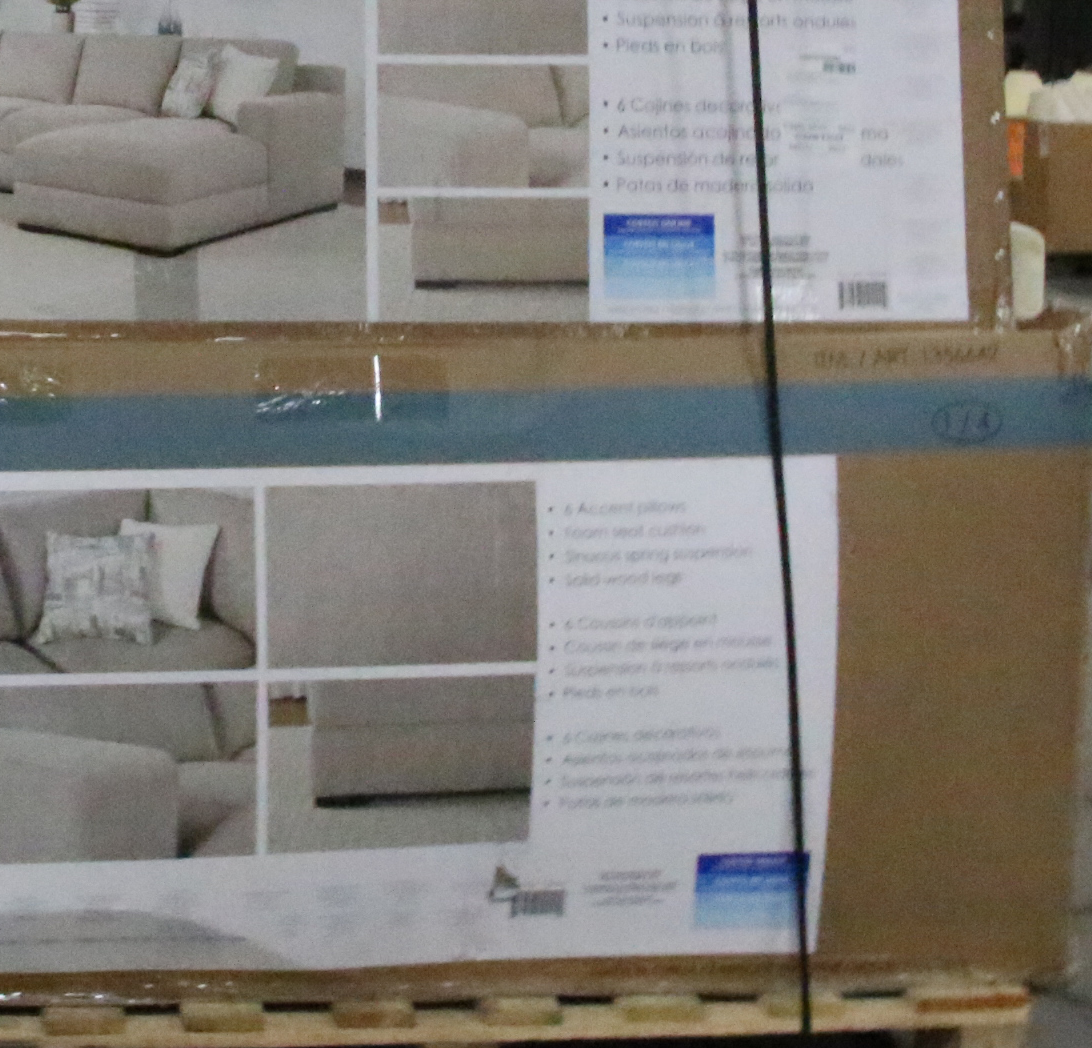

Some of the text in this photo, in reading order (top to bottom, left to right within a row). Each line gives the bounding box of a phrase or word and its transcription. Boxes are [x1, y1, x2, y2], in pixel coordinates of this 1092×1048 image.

[616, 12, 710, 32] Suspension
[615, 38, 660, 54] Pieds
[665, 40, 686, 54] en
[616, 99, 626, 113] 6
[630, 97, 692, 116] Cojines
[617, 124, 688, 140] Asientos
[712, 152, 734, 167] de
[616, 176, 662, 193] Patas
[666, 177, 688, 193] de
[577, 500, 635, 515] Accent
